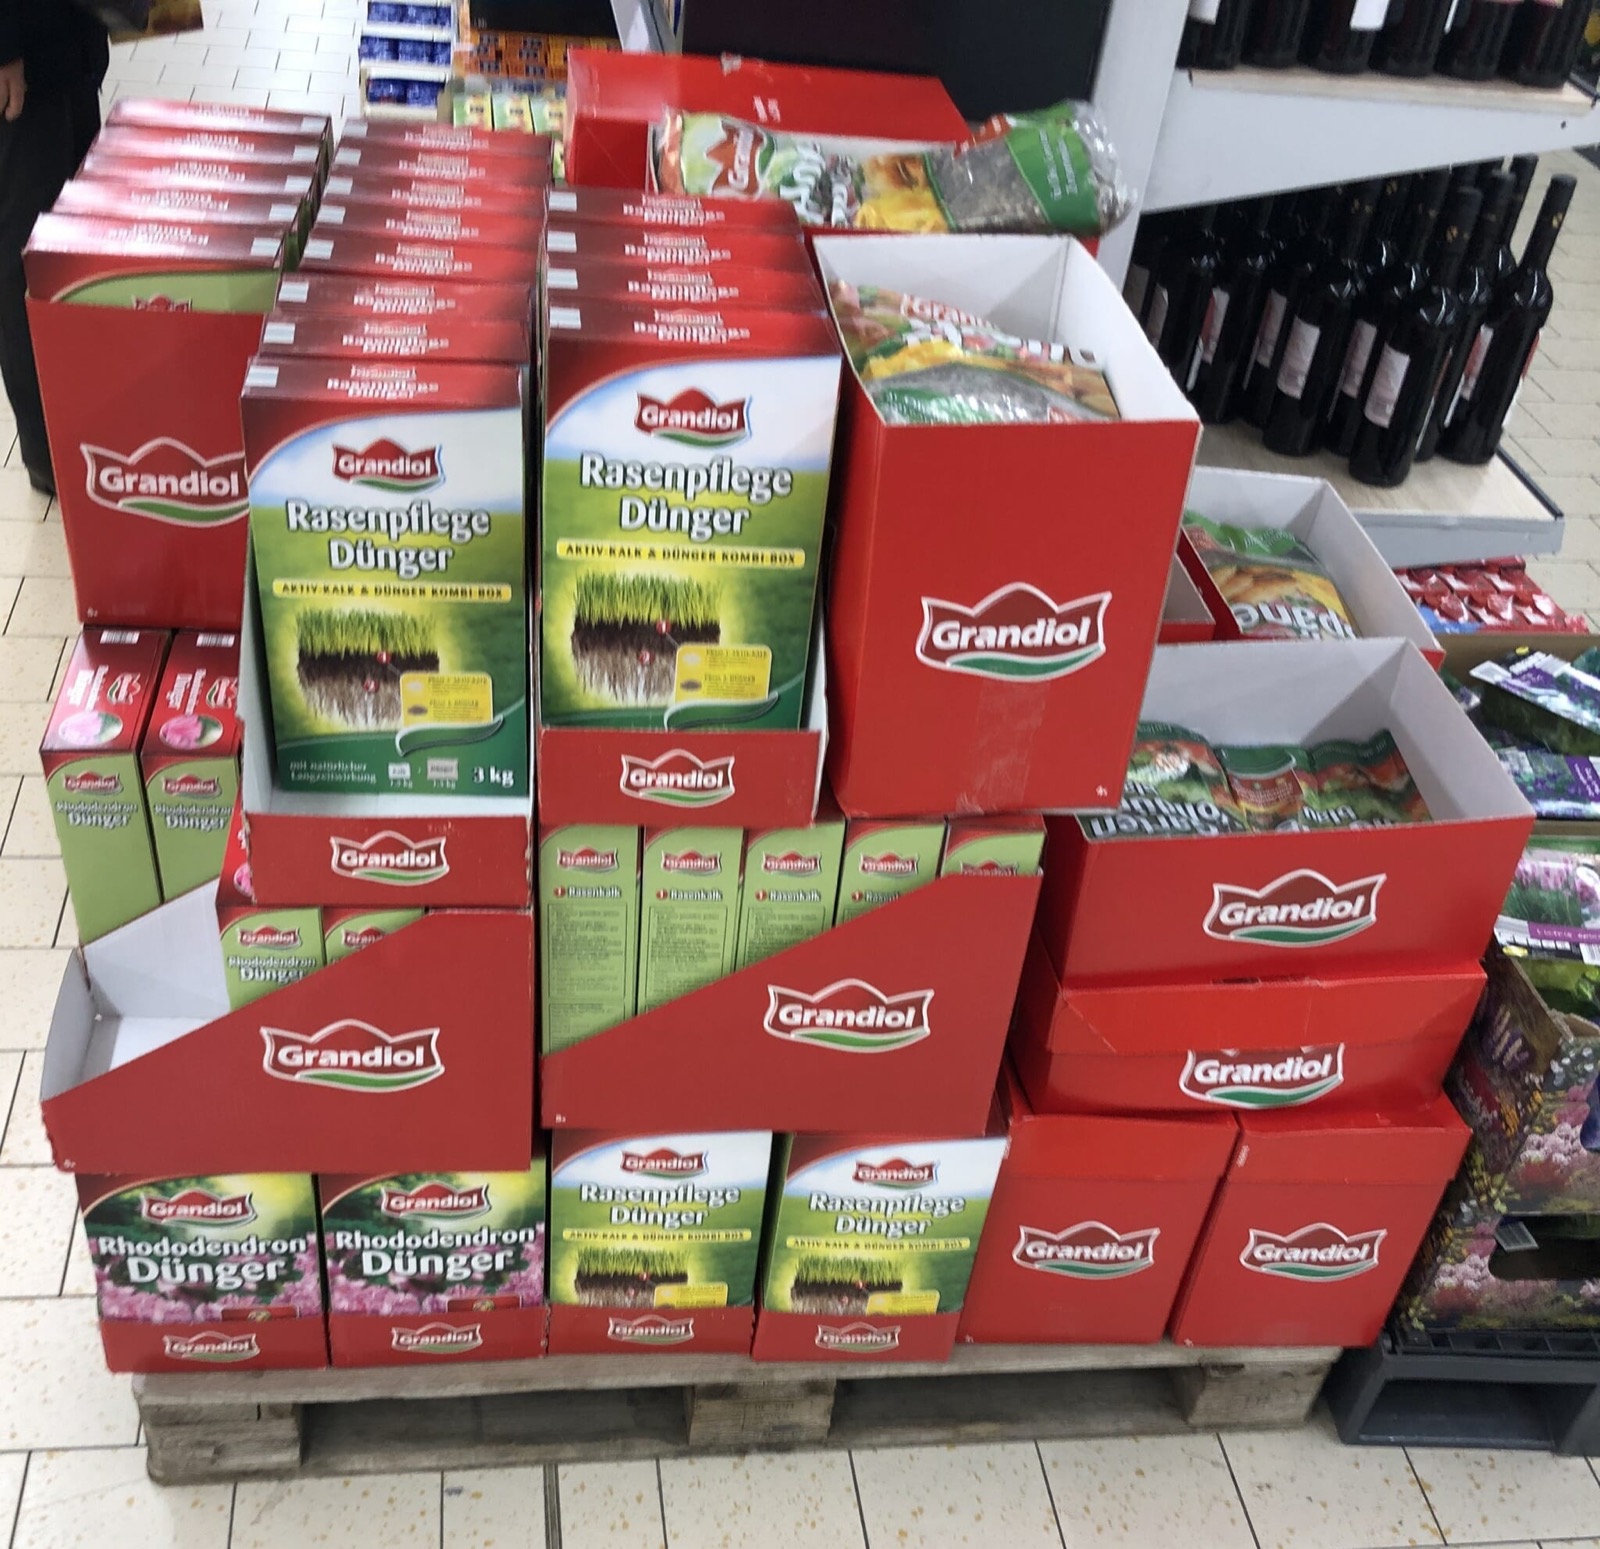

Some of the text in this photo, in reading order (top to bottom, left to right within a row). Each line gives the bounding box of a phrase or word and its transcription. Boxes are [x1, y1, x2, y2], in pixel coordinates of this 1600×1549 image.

[641, 404, 738, 430] Grandiol
[338, 455, 431, 476] Grandiol
[580, 451, 792, 504] Rasenpflege
[100, 466, 239, 497] Grandiol
[286, 499, 490, 543] Rasenpflege
[619, 495, 751, 542] Dünger
[329, 538, 454, 579] Dünger
[931, 616, 1091, 650] Grandiol
[473, 766, 484, 783] 3
[490, 766, 514, 788] kg
[629, 769, 723, 789] Grandiol
[341, 848, 437, 867] Grandiol
[1218, 894, 1365, 926] Grandiol
[778, 1003, 916, 1028] Grandiol
[277, 1045, 425, 1068] Grandiol
[1194, 1053, 1333, 1084] Grandiol
[625, 1156, 699, 1170] Grandiol
[857, 1168, 930, 1182] Grandiol
[390, 1194, 478, 1210] Grandiol
[580, 1181, 741, 1208] Rasenpflege
[809, 1190, 965, 1218] Rasenpflege
[150, 1201, 242, 1216] Grandiol
[610, 1206, 709, 1230] Dünger
[335, 1225, 535, 1250] Rhododendron
[835, 1214, 933, 1239] Dünger
[99, 1235, 307, 1257] Rhododendron
[1026, 1239, 1144, 1262] Grandiol
[1252, 1241, 1370, 1263] Grandiol
[126, 1256, 286, 1291] Dünger
[361, 1249, 514, 1281] Dünger
[172, 1340, 250, 1354] Grandiol
[398, 1331, 474, 1345] Grandiol
